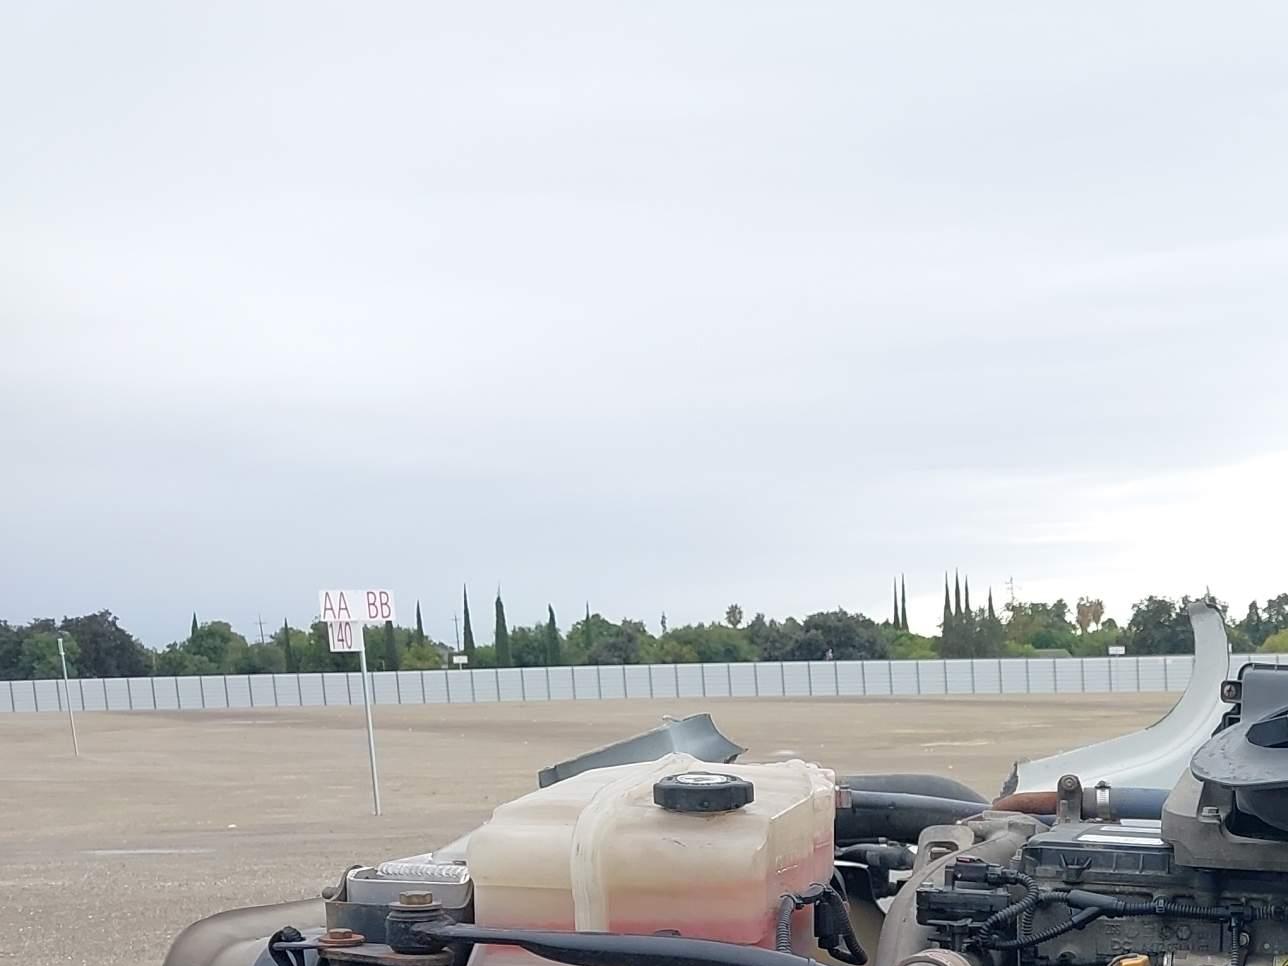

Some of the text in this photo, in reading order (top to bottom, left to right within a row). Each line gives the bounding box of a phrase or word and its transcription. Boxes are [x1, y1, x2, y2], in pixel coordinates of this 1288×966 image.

[323, 591, 391, 619] AA BB
[329, 622, 353, 650] 140
